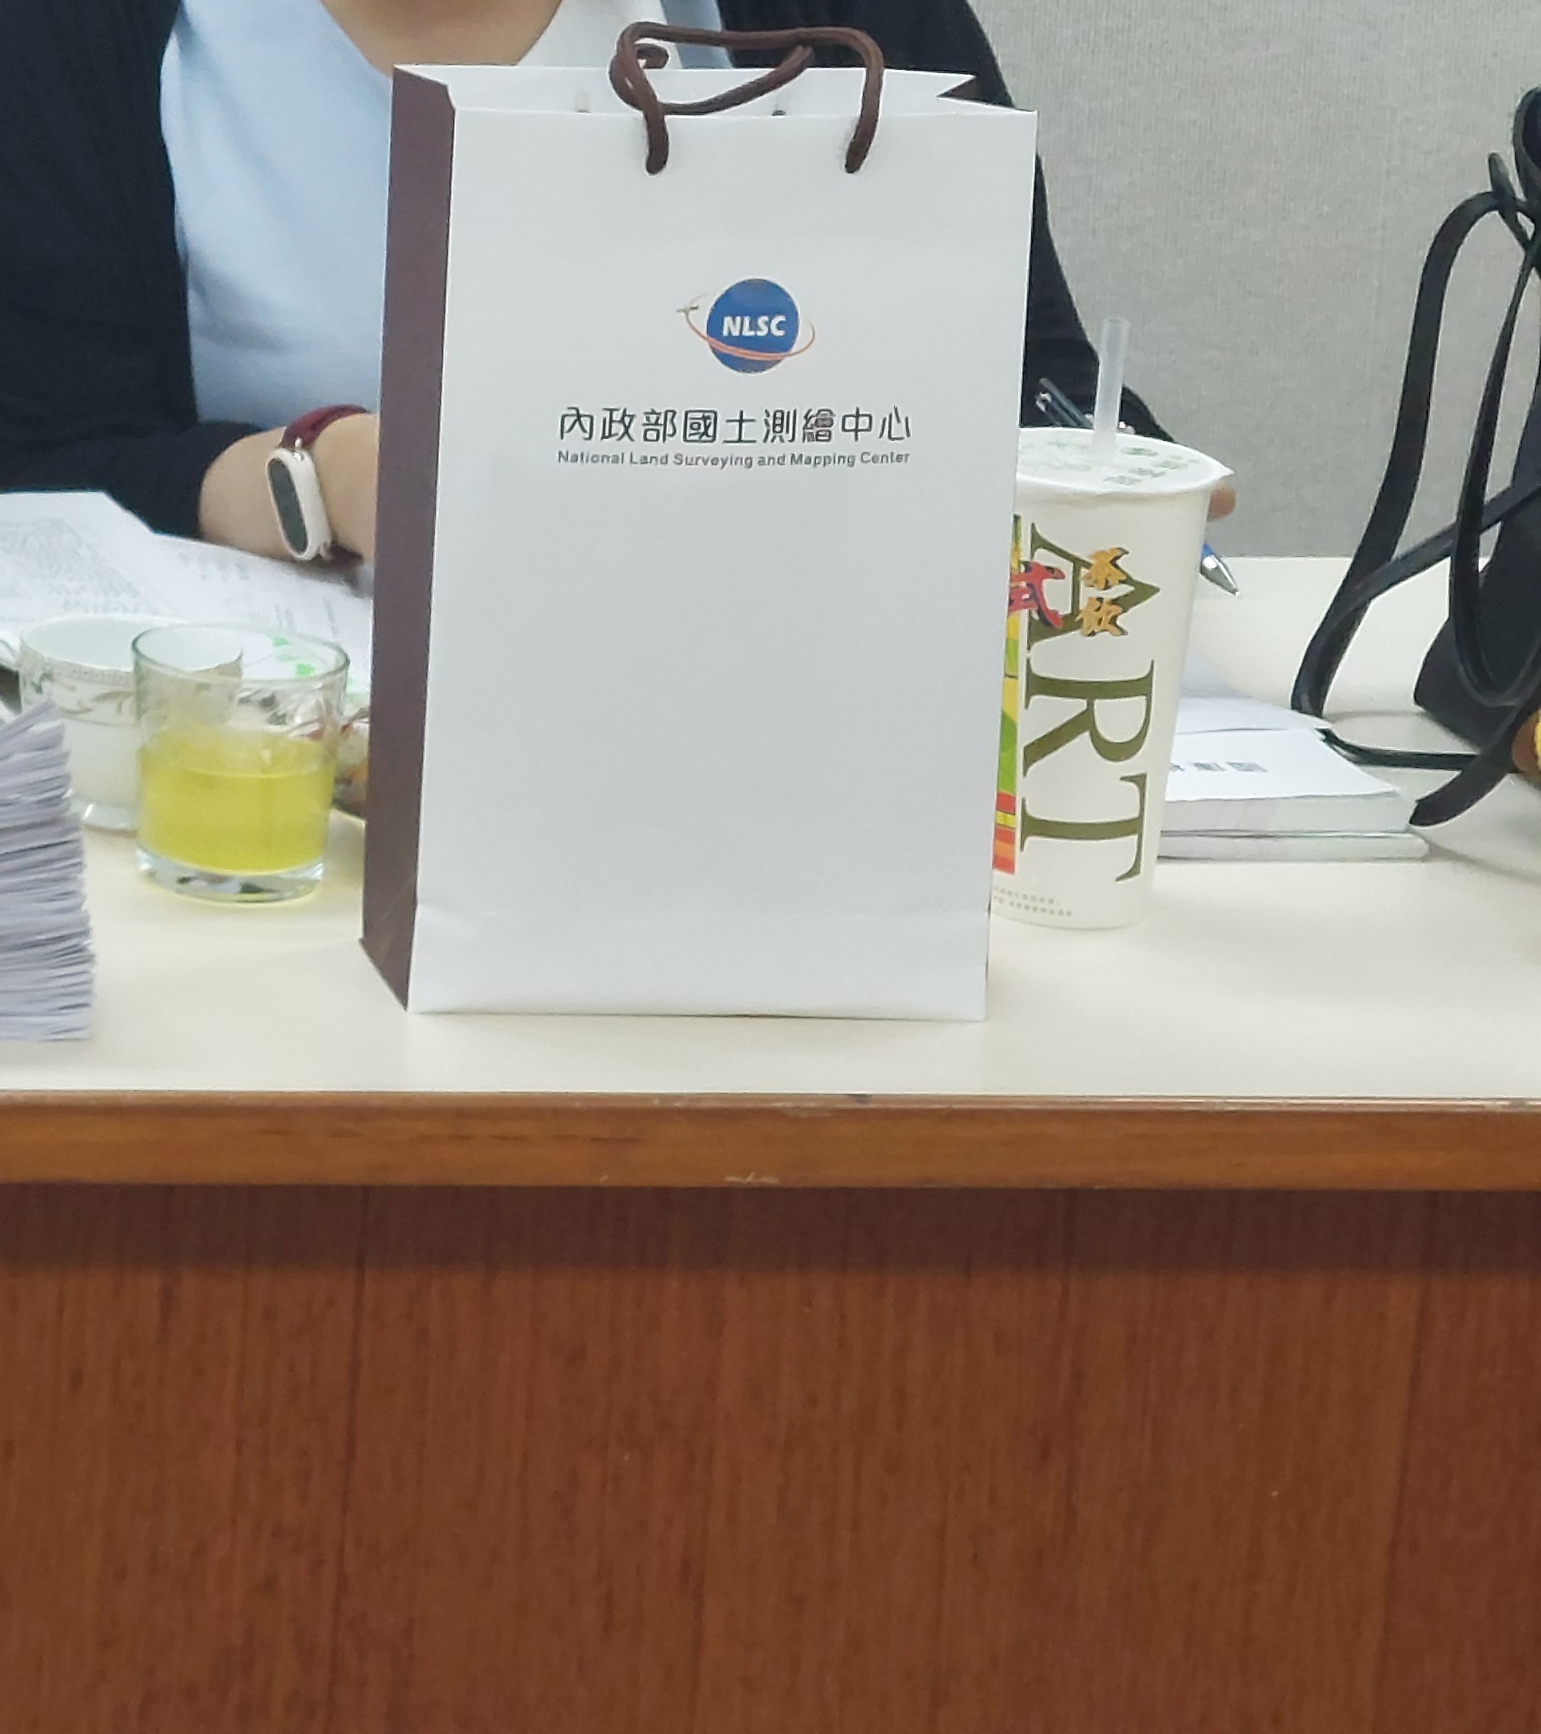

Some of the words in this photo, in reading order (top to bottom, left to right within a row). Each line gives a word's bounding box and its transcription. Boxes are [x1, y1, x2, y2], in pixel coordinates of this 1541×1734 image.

[722, 315, 787, 337] NLSC
[559, 404, 911, 444] 內政部國土測繪中心
[558, 450, 624, 464] National
[630, 452, 668, 466] Land
[673, 452, 753, 470] Surveying
[757, 453, 786, 466] and
[790, 452, 856, 468] Mapping
[860, 450, 911, 465] Center
[1020, 521, 1161, 883] ART
